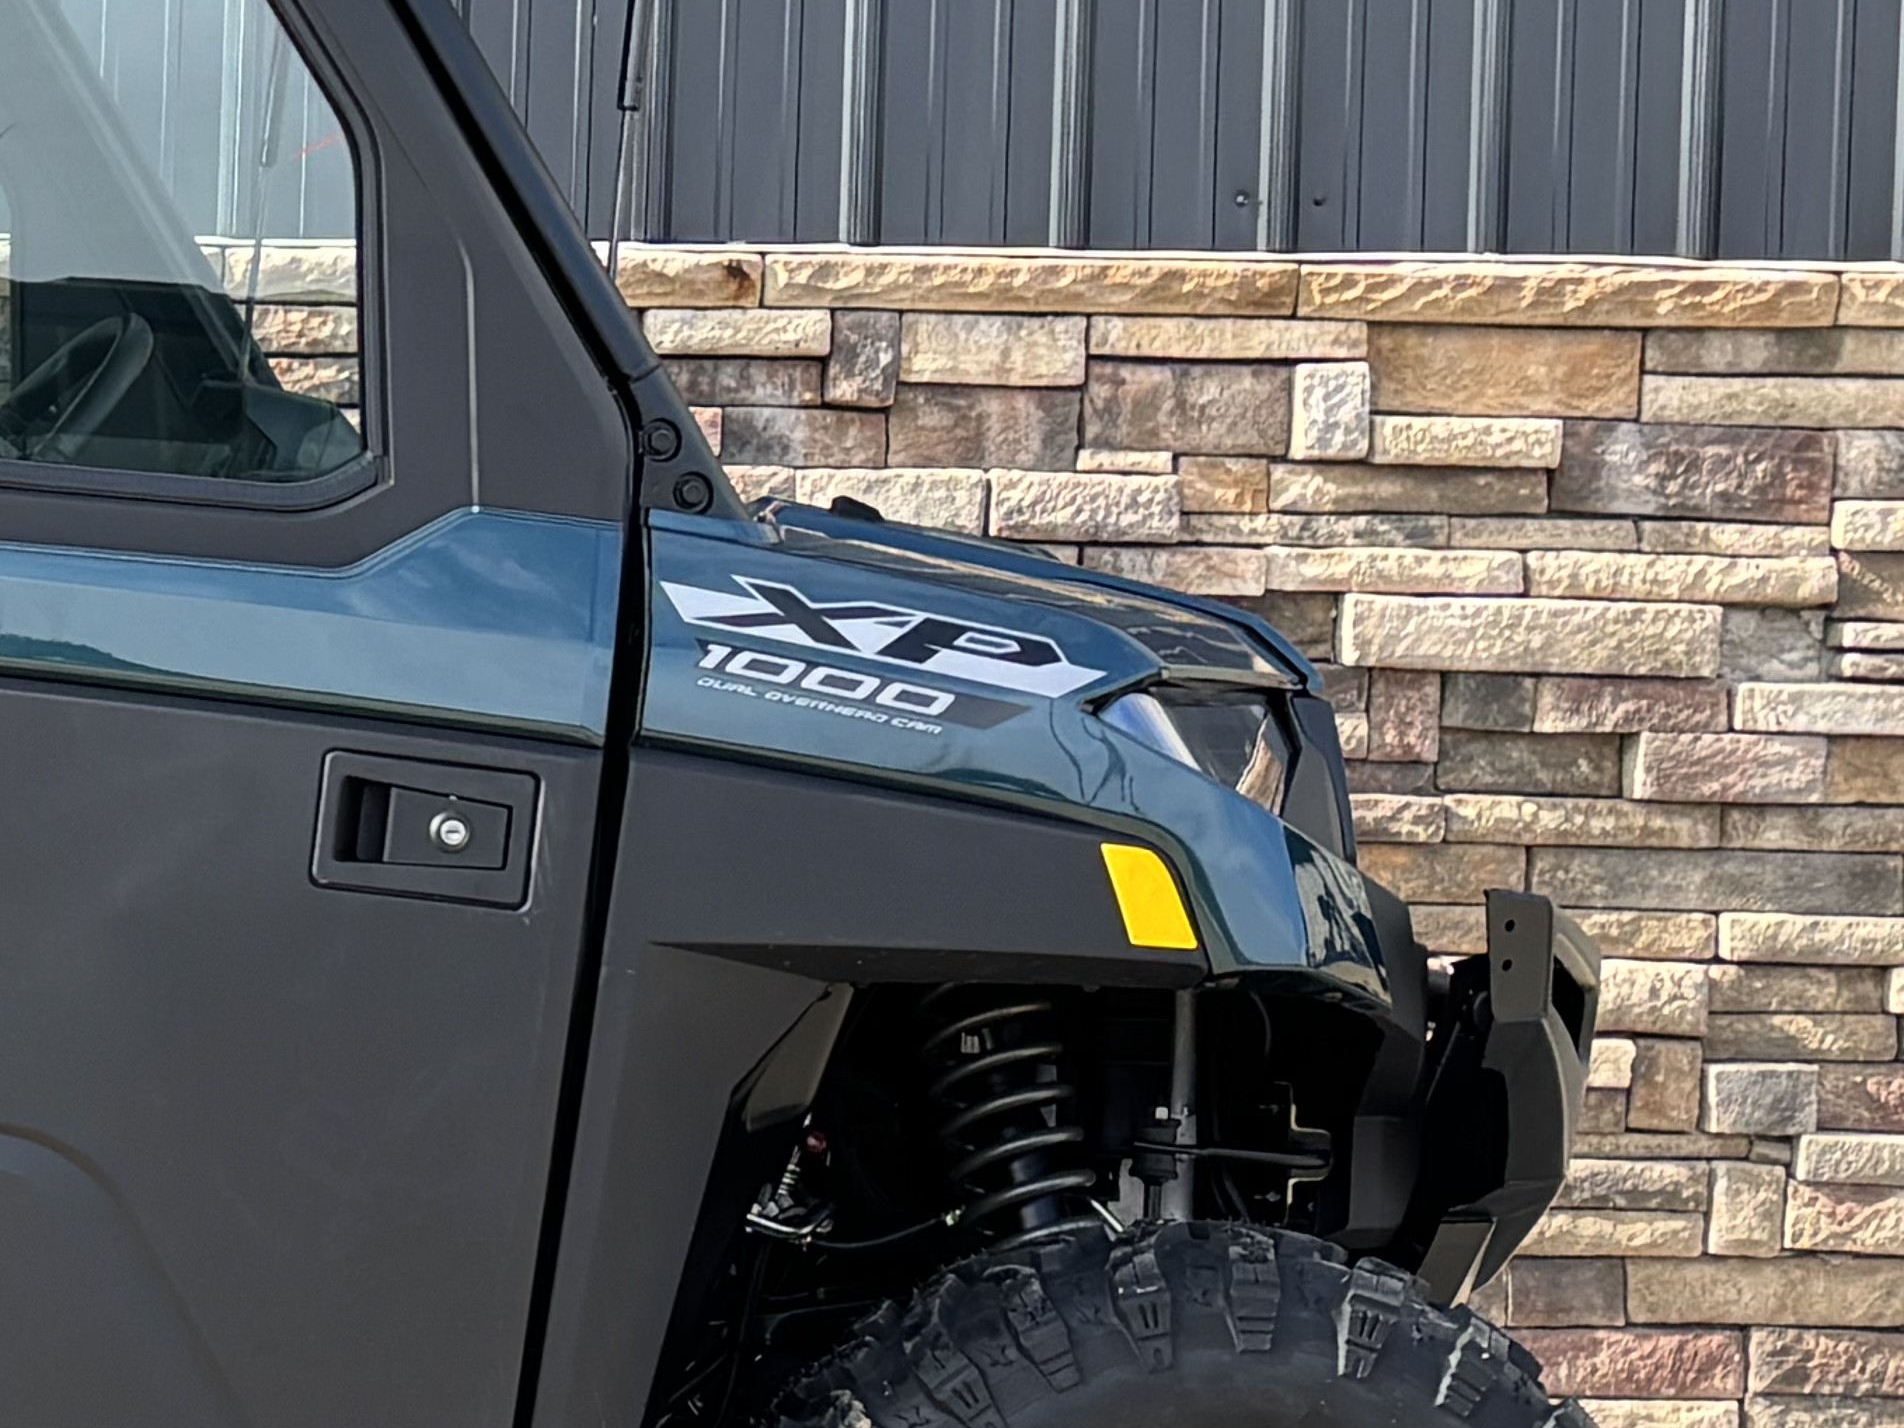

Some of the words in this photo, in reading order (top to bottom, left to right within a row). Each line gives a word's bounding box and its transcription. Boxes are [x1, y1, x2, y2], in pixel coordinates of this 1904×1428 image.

[692, 577, 1067, 671] XP
[696, 676, 757, 697] DUAL
[764, 689, 889, 724] OVERHEAD
[890, 716, 943, 735] CAM
[698, 643, 956, 716] 1000
